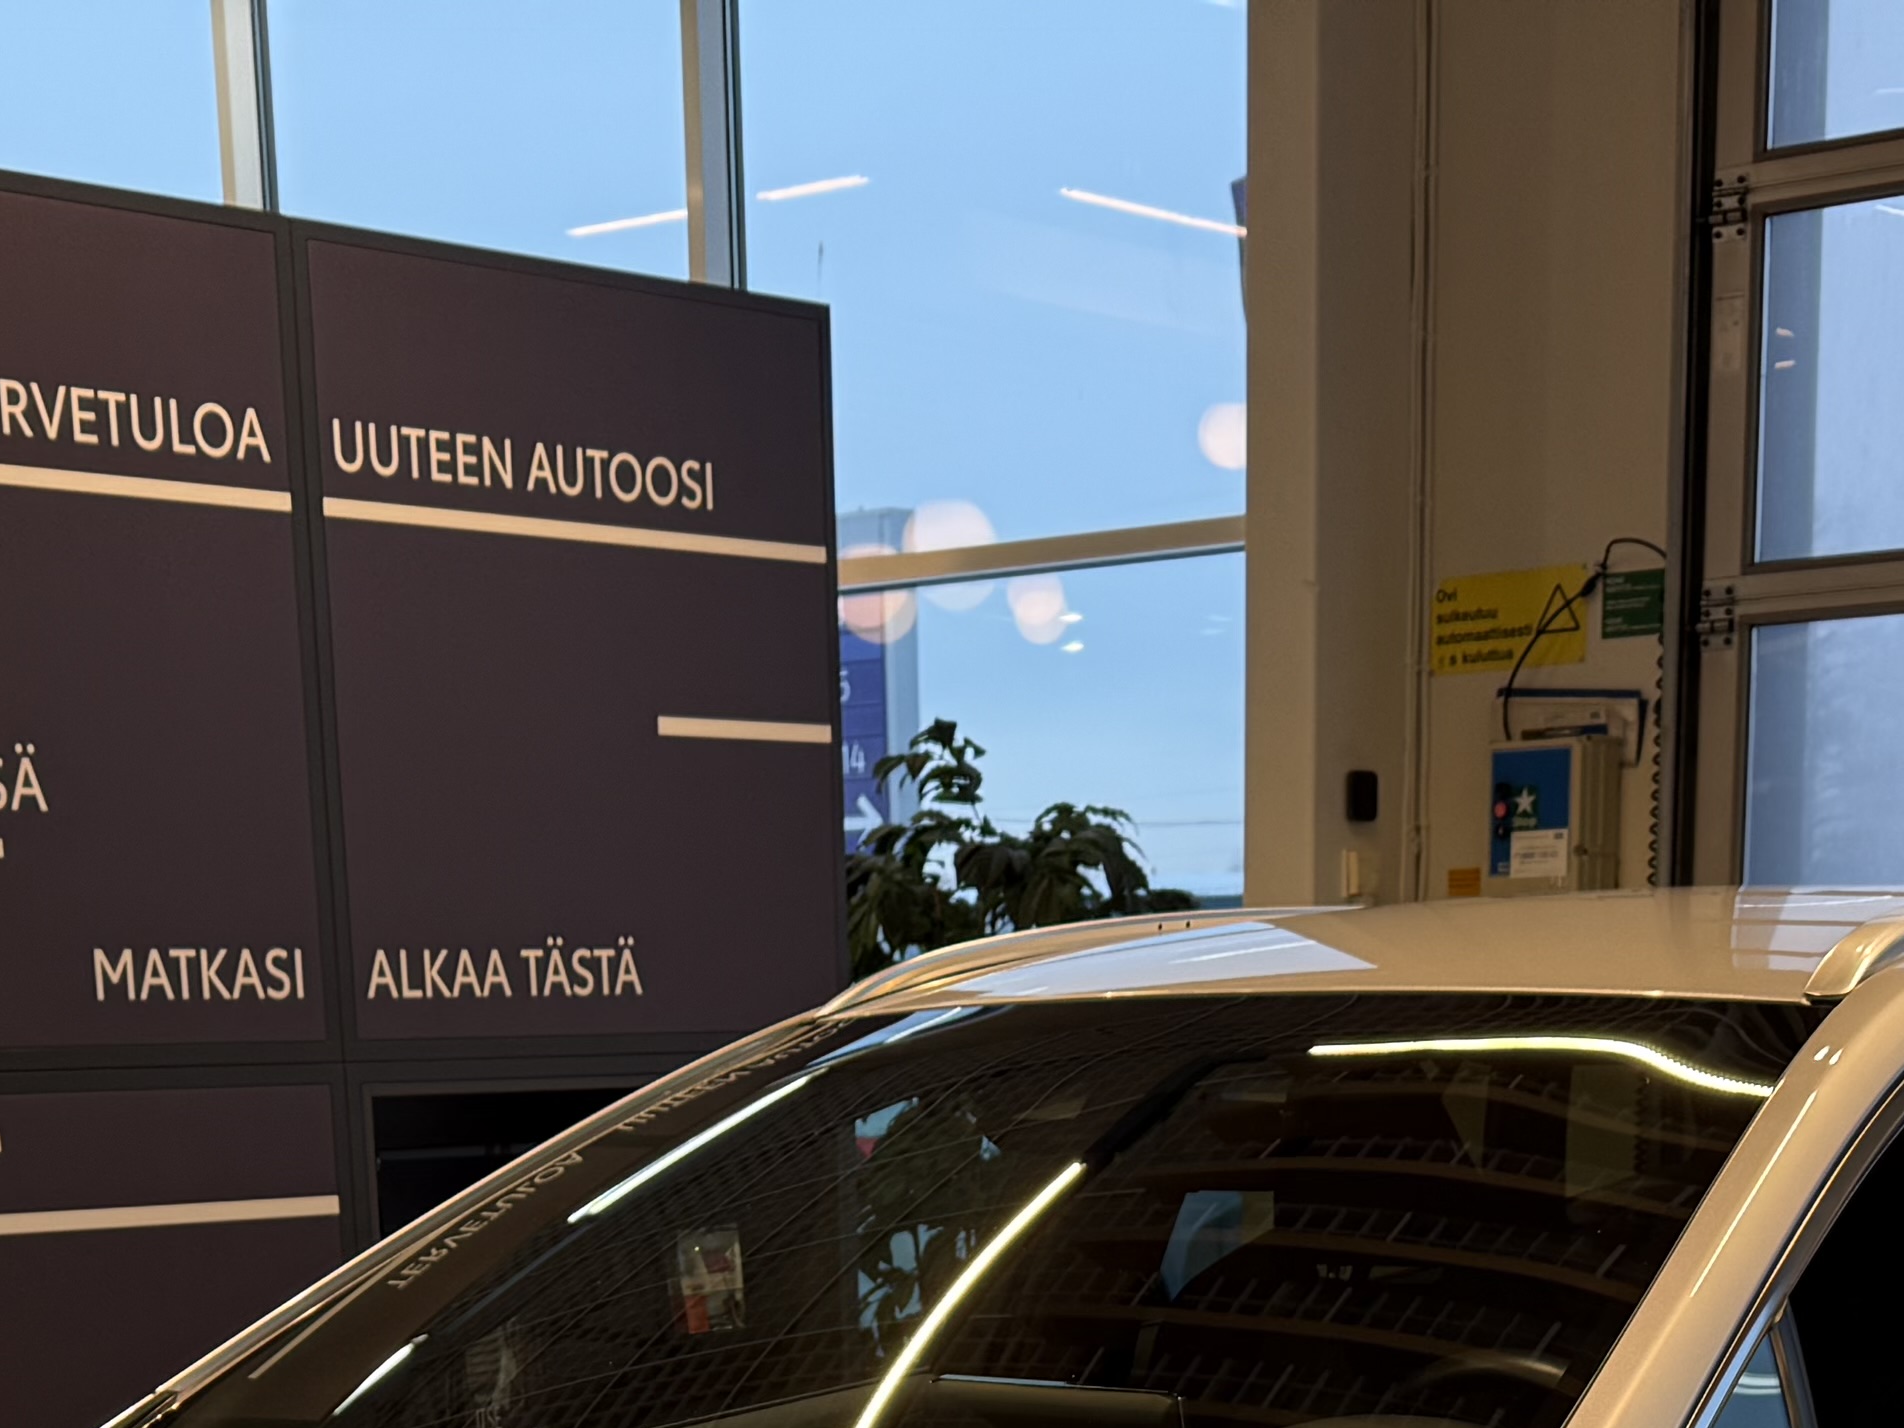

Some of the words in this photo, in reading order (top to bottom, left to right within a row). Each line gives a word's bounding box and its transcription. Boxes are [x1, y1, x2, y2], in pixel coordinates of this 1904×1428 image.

[332, 417, 513, 489] UUTEEN
[527, 441, 714, 511] AUTOOSI
[1435, 587, 1458, 604] Ovi
[93, 947, 305, 1001] MATKASI
[367, 948, 513, 1000] ALKAA
[519, 936, 643, 998] TÄSTÄ
